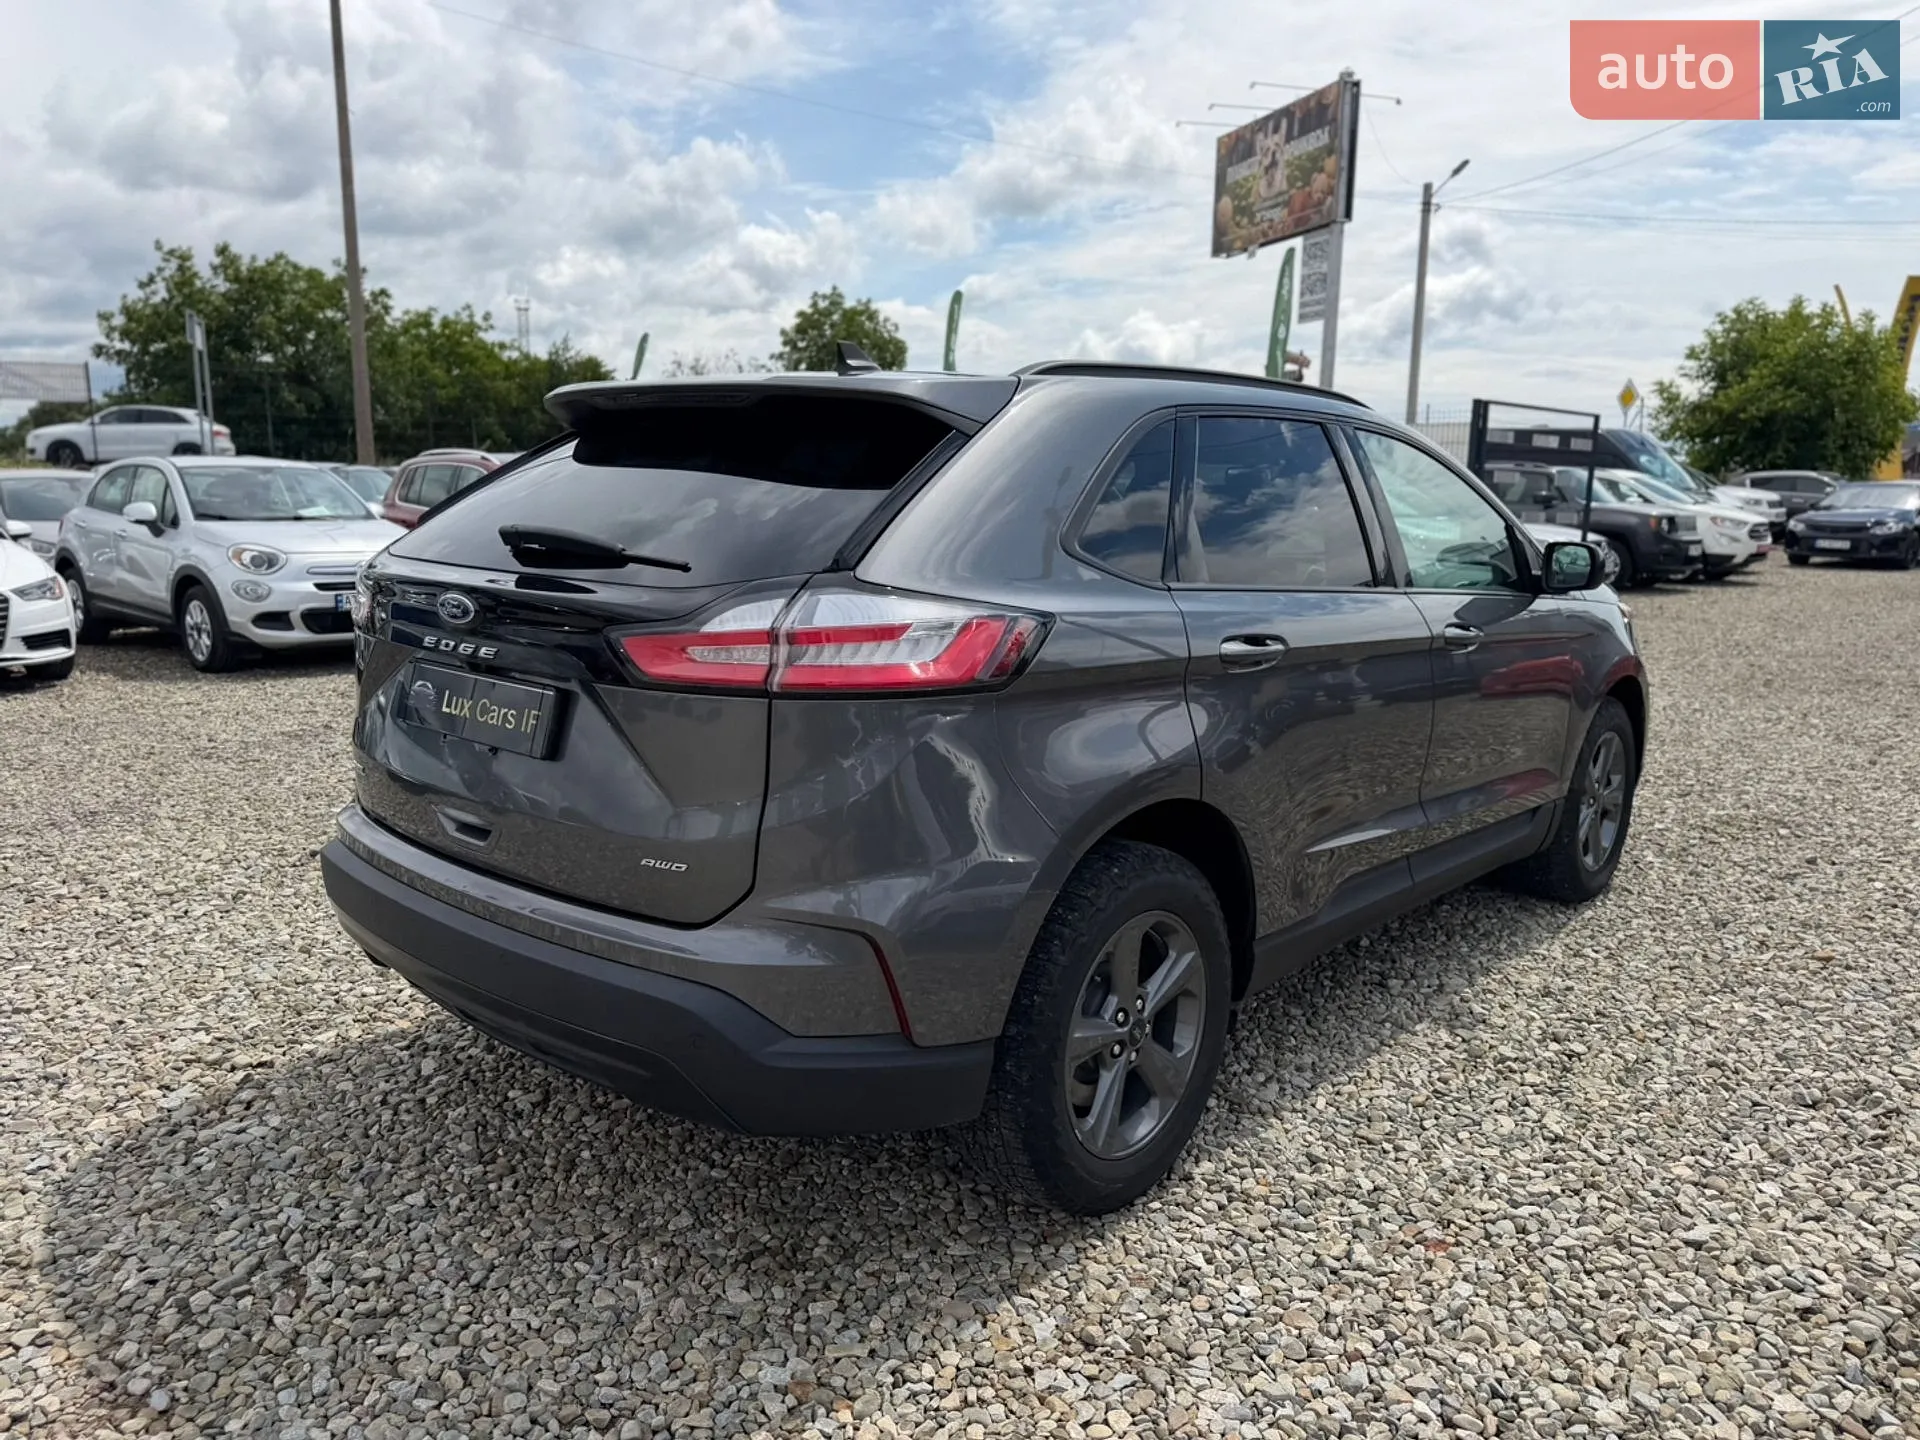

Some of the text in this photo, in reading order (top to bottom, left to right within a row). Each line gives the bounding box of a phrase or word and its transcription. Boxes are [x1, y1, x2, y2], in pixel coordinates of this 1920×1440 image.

[423, 636, 498, 659] EDGE
[441, 690, 542, 733] Lux Cars IF
[640, 858, 689, 871] AWD
